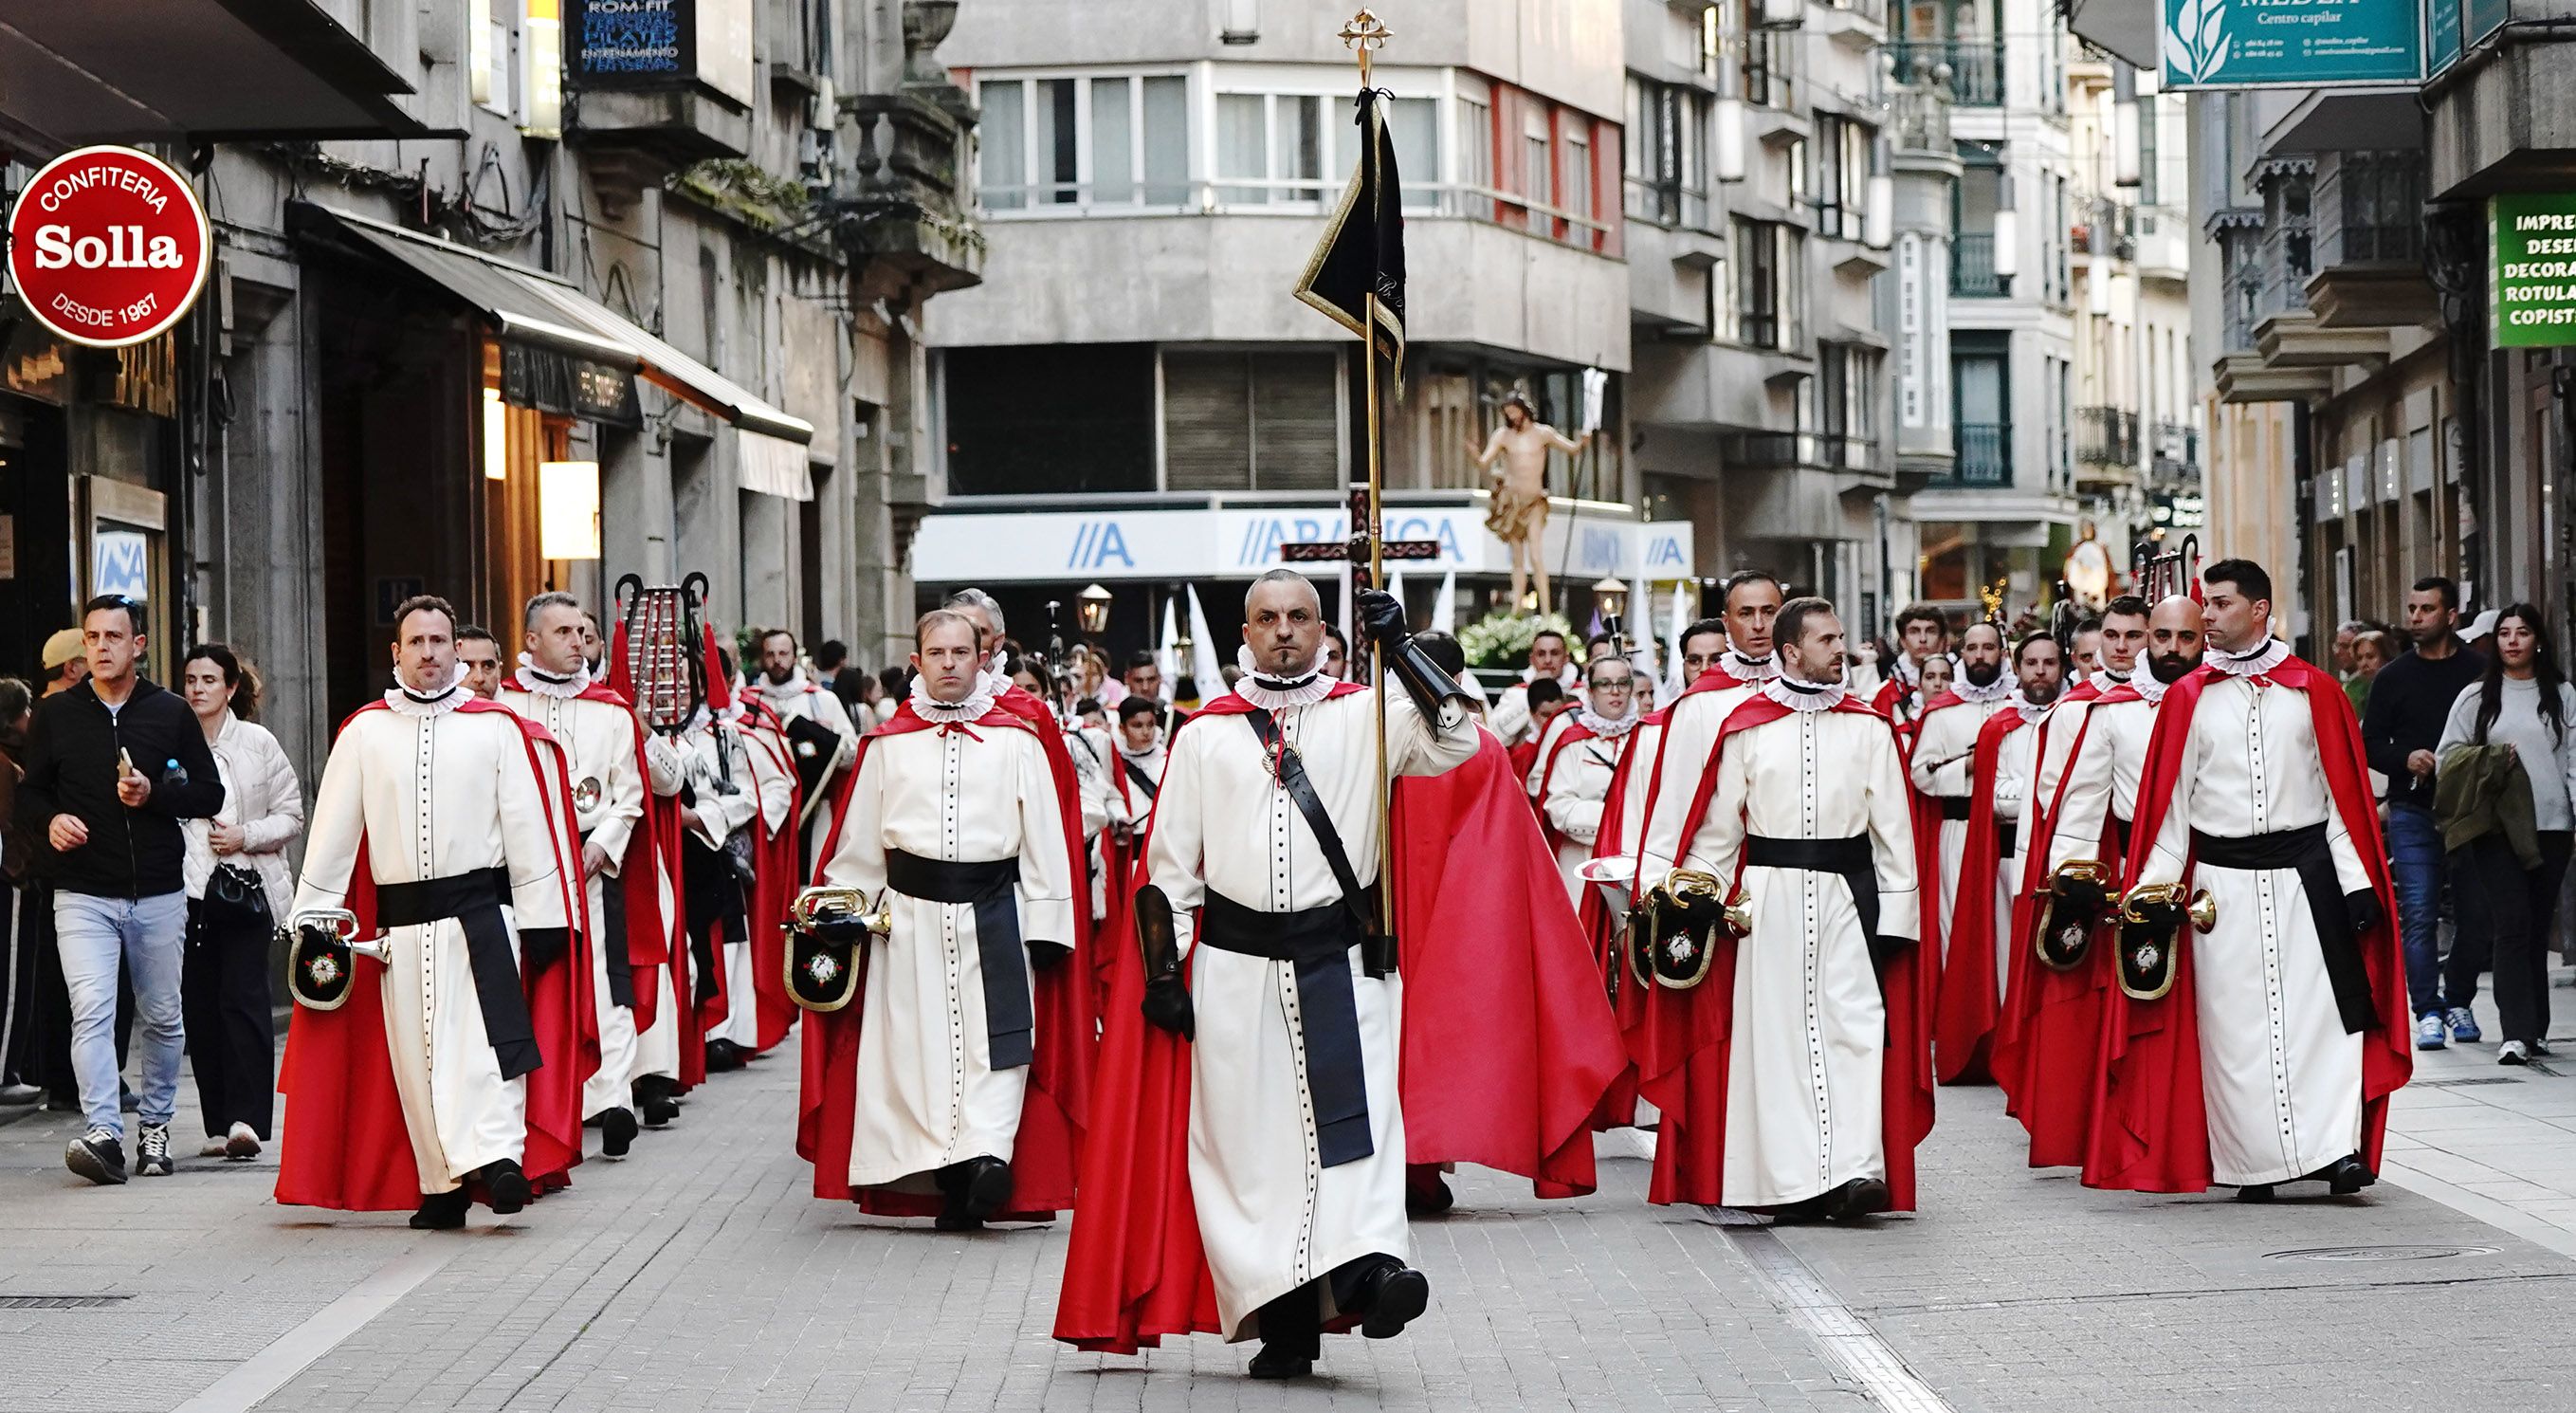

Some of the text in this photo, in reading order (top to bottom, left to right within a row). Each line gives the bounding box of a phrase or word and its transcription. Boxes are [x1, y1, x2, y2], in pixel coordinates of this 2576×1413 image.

[2256, 10, 2343, 27] Centro capilar
[40, 166, 168, 214] CONFITERIA
[2515, 214, 2576, 230] IMPRE
[34, 224, 184, 269] Solla
[2526, 238, 2576, 254] DESE
[51, 292, 158, 327] DESDE 1967
[2509, 307, 2576, 325] COPIST
